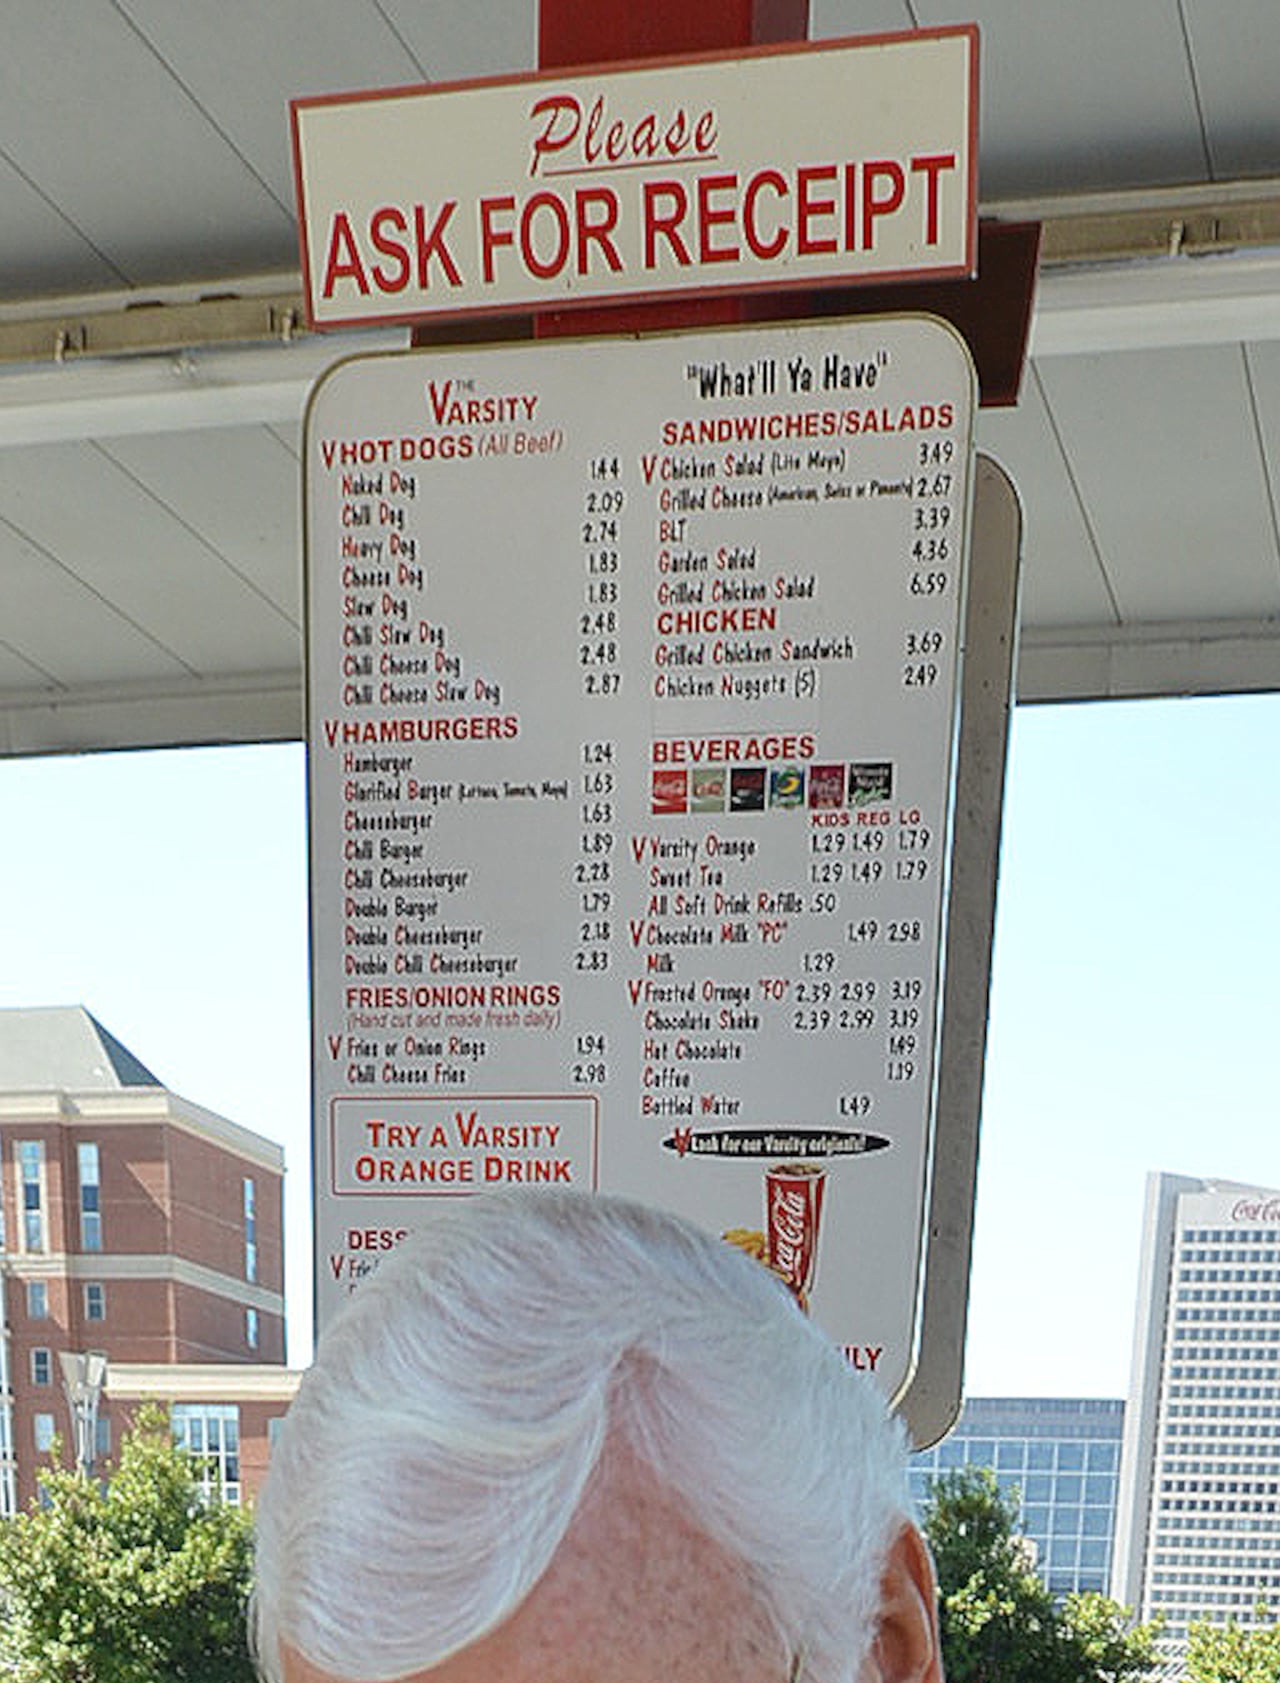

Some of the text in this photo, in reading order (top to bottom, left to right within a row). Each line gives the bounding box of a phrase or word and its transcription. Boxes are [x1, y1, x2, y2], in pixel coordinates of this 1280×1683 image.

[530, 94, 718, 177] Please
[322, 155, 957, 299] ASK FOR RECEIPT
[456, 380, 475, 392] THE
[788, 358, 812, 392] Ya
[663, 404, 954, 446] SANDWICHES/SALADS
[322, 429, 563, 470] V HOT DOGS (All Beef)
[642, 442, 953, 485] V Chicken Salad 3.49
[659, 488, 705, 512] Grilled
[711, 484, 762, 508] Cheese
[917, 475, 951, 498] 2.67
[341, 491, 623, 530] Chili Dog 2.09
[660, 508, 950, 542] BLT 3.39
[342, 553, 619, 592] Cheese Dog 1.83
[659, 540, 948, 573] Garden Salad 4.36
[658, 573, 947, 605] Grilled Chicken Salad 6.59
[657, 607, 777, 635] CHICKEN
[655, 632, 943, 667] Grilled Chicken Sandwich 3.69
[655, 664, 938, 700] Chicken Nuggets (5) 2.49
[324, 716, 519, 747] V HAMBURGERS
[344, 745, 613, 778] Hamburger 1.24
[652, 736, 816, 764] BEVERAGES
[344, 780, 401, 803] Glorified
[407, 780, 453, 805] Burger
[584, 773, 613, 794] 1.63
[344, 803, 612, 836] Cheeseburger 1.63
[811, 811, 891, 828] KIDS REG
[632, 829, 930, 863] V Varsity Orange 1.29 1.49 1.79
[650, 858, 928, 888] Sweet Tea 1.29 1.49 1.79
[648, 891, 837, 917] All Soft Drink Refills .50
[344, 922, 610, 950] Double Cheeseburger 2.18
[630, 920, 644, 946] V
[647, 921, 713, 946] Chocolate
[720, 921, 748, 944] Milk
[848, 920, 878, 943] 1.49
[888, 920, 921, 942] 2.98
[647, 952, 835, 973] Milk 1.29
[490, 984, 562, 1008] RINGS
[628, 979, 642, 1006] V
[645, 981, 696, 1002] Frosted
[702, 979, 751, 1004] Orange
[796, 981, 831, 1003] 2.39
[840, 981, 876, 1002] 2.99
[892, 980, 921, 1000] 3.19
[644, 1008, 919, 1032] Chocolate Shake 2.39 2.99 3.19
[328, 1035, 342, 1060] V
[347, 1036, 378, 1057] Fries
[385, 1040, 398, 1057] or
[404, 1035, 443, 1056] Onion
[449, 1036, 486, 1061] Rings
[643, 1066, 691, 1088] Coffee
[642, 1093, 871, 1116] Bottled Water 1.49
[367, 1111, 561, 1148] TRY A VARSITY
[355, 1156, 572, 1183] ORANGE DRINK
[772, 1187, 806, 1275] oca-Cola
